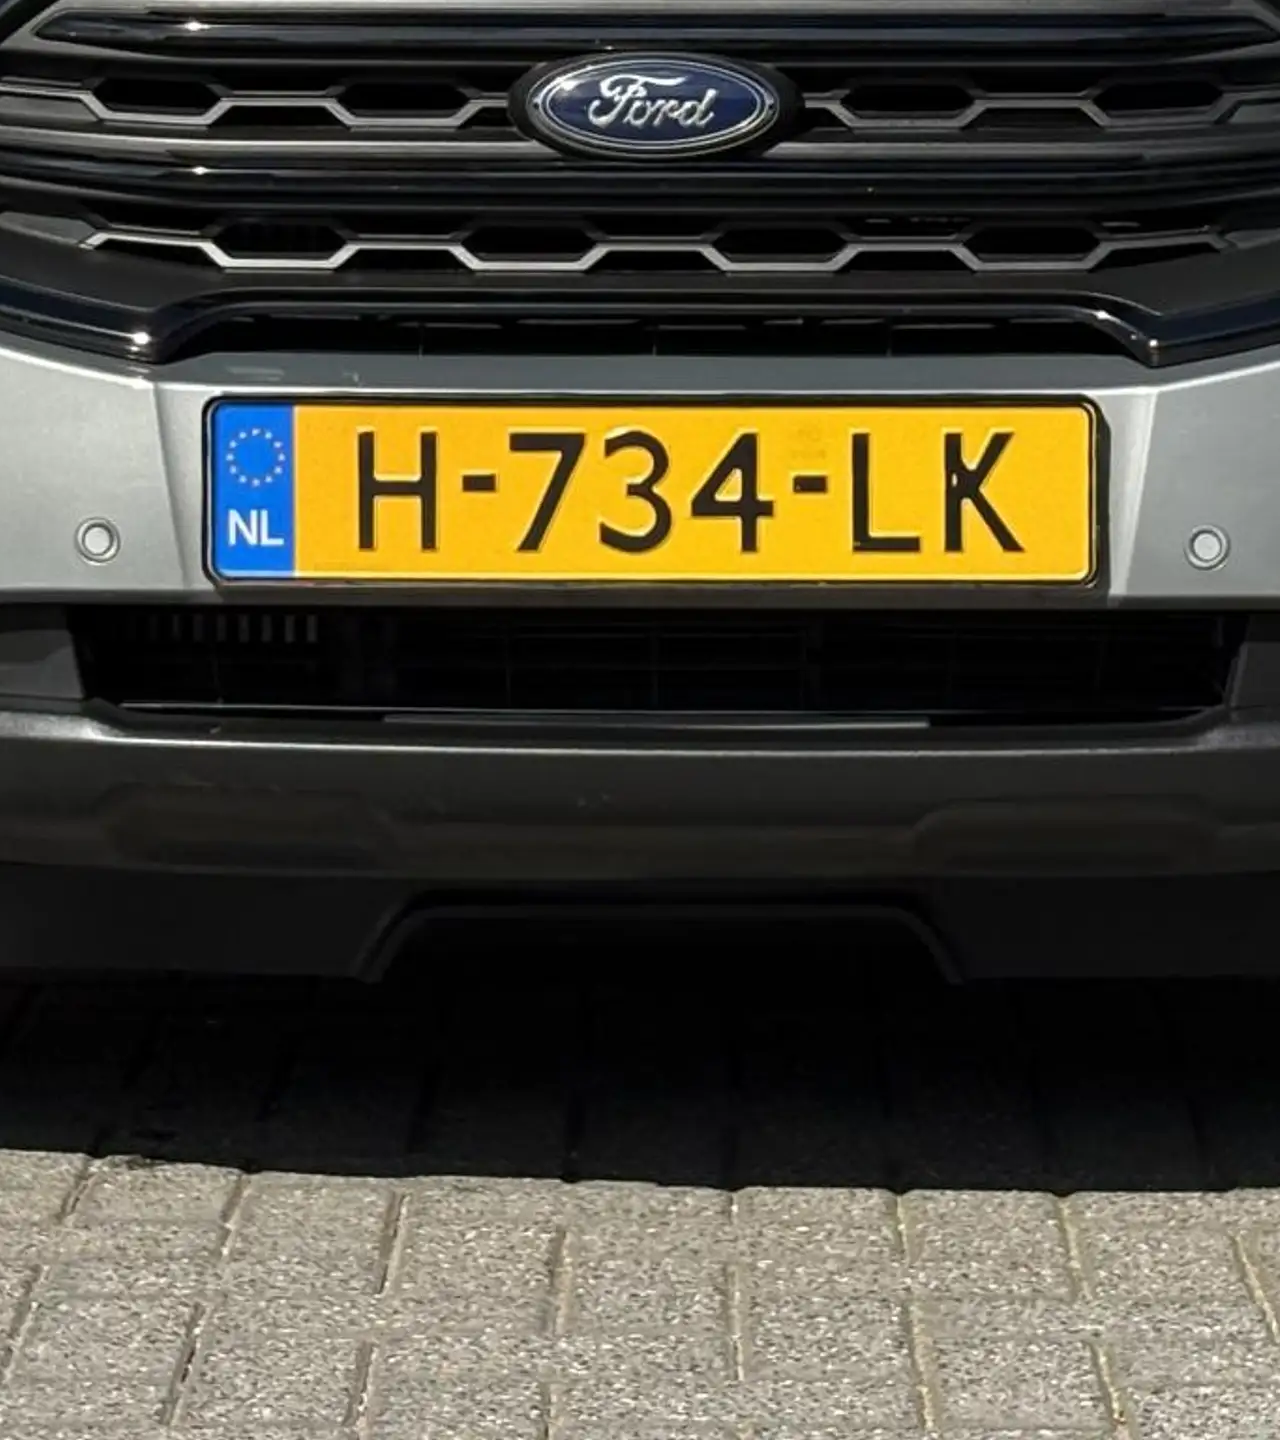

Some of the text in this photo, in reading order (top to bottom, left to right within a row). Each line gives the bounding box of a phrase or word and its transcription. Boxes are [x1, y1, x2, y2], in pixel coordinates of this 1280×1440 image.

[588, 73, 718, 130] Ford
[356, 430, 1024, 555] H-734-LK
[228, 509, 284, 547] NL
